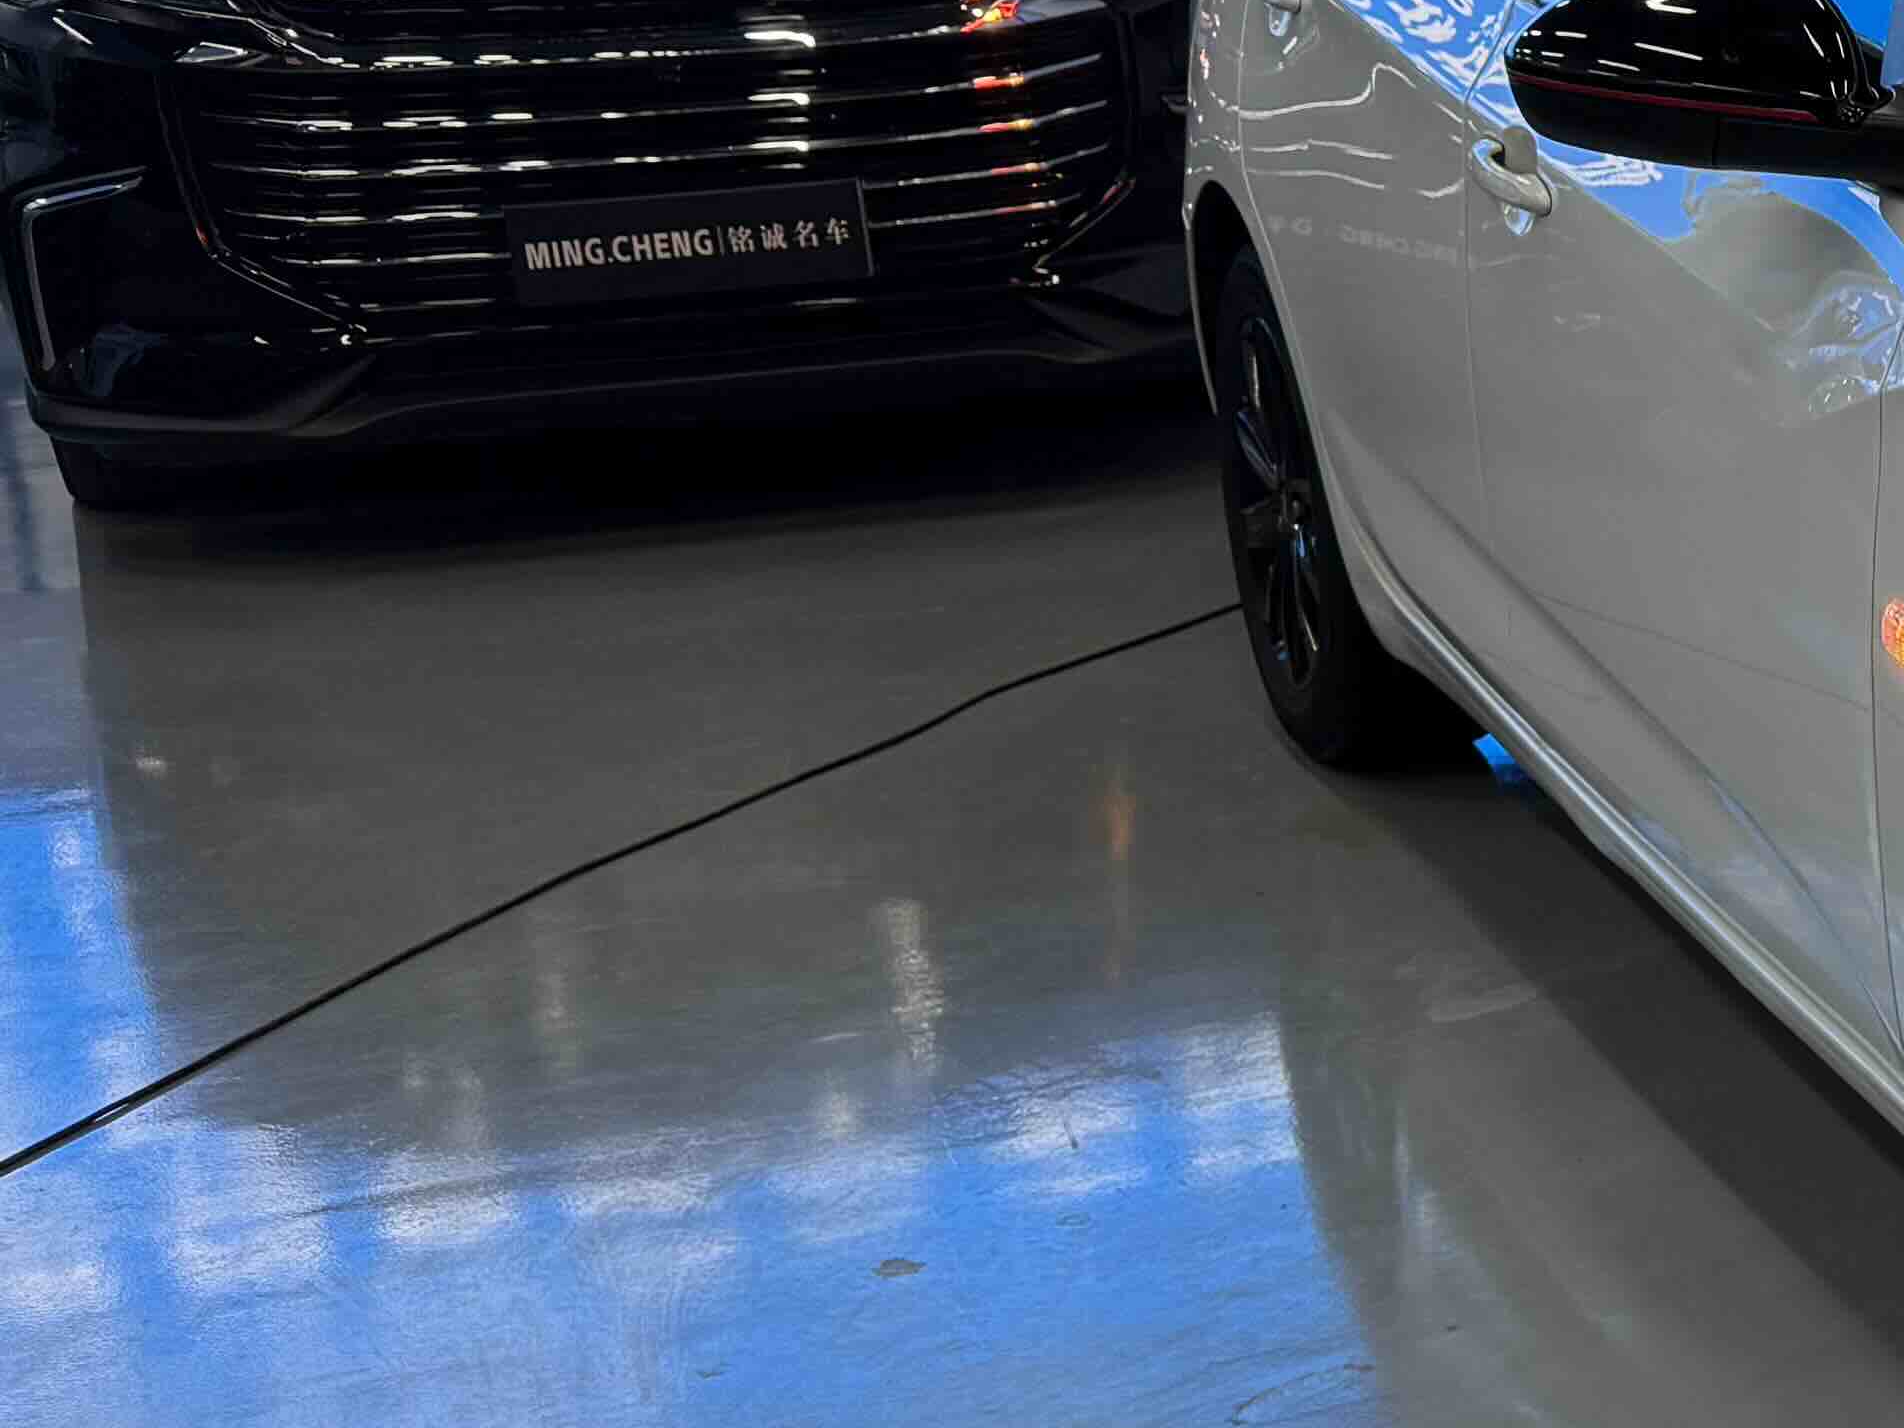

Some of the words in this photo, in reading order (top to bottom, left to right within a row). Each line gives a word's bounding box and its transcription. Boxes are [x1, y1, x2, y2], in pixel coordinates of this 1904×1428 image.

[523, 227, 715, 271] MING.CHENG
[727, 217, 849, 254] 铭诚名车
